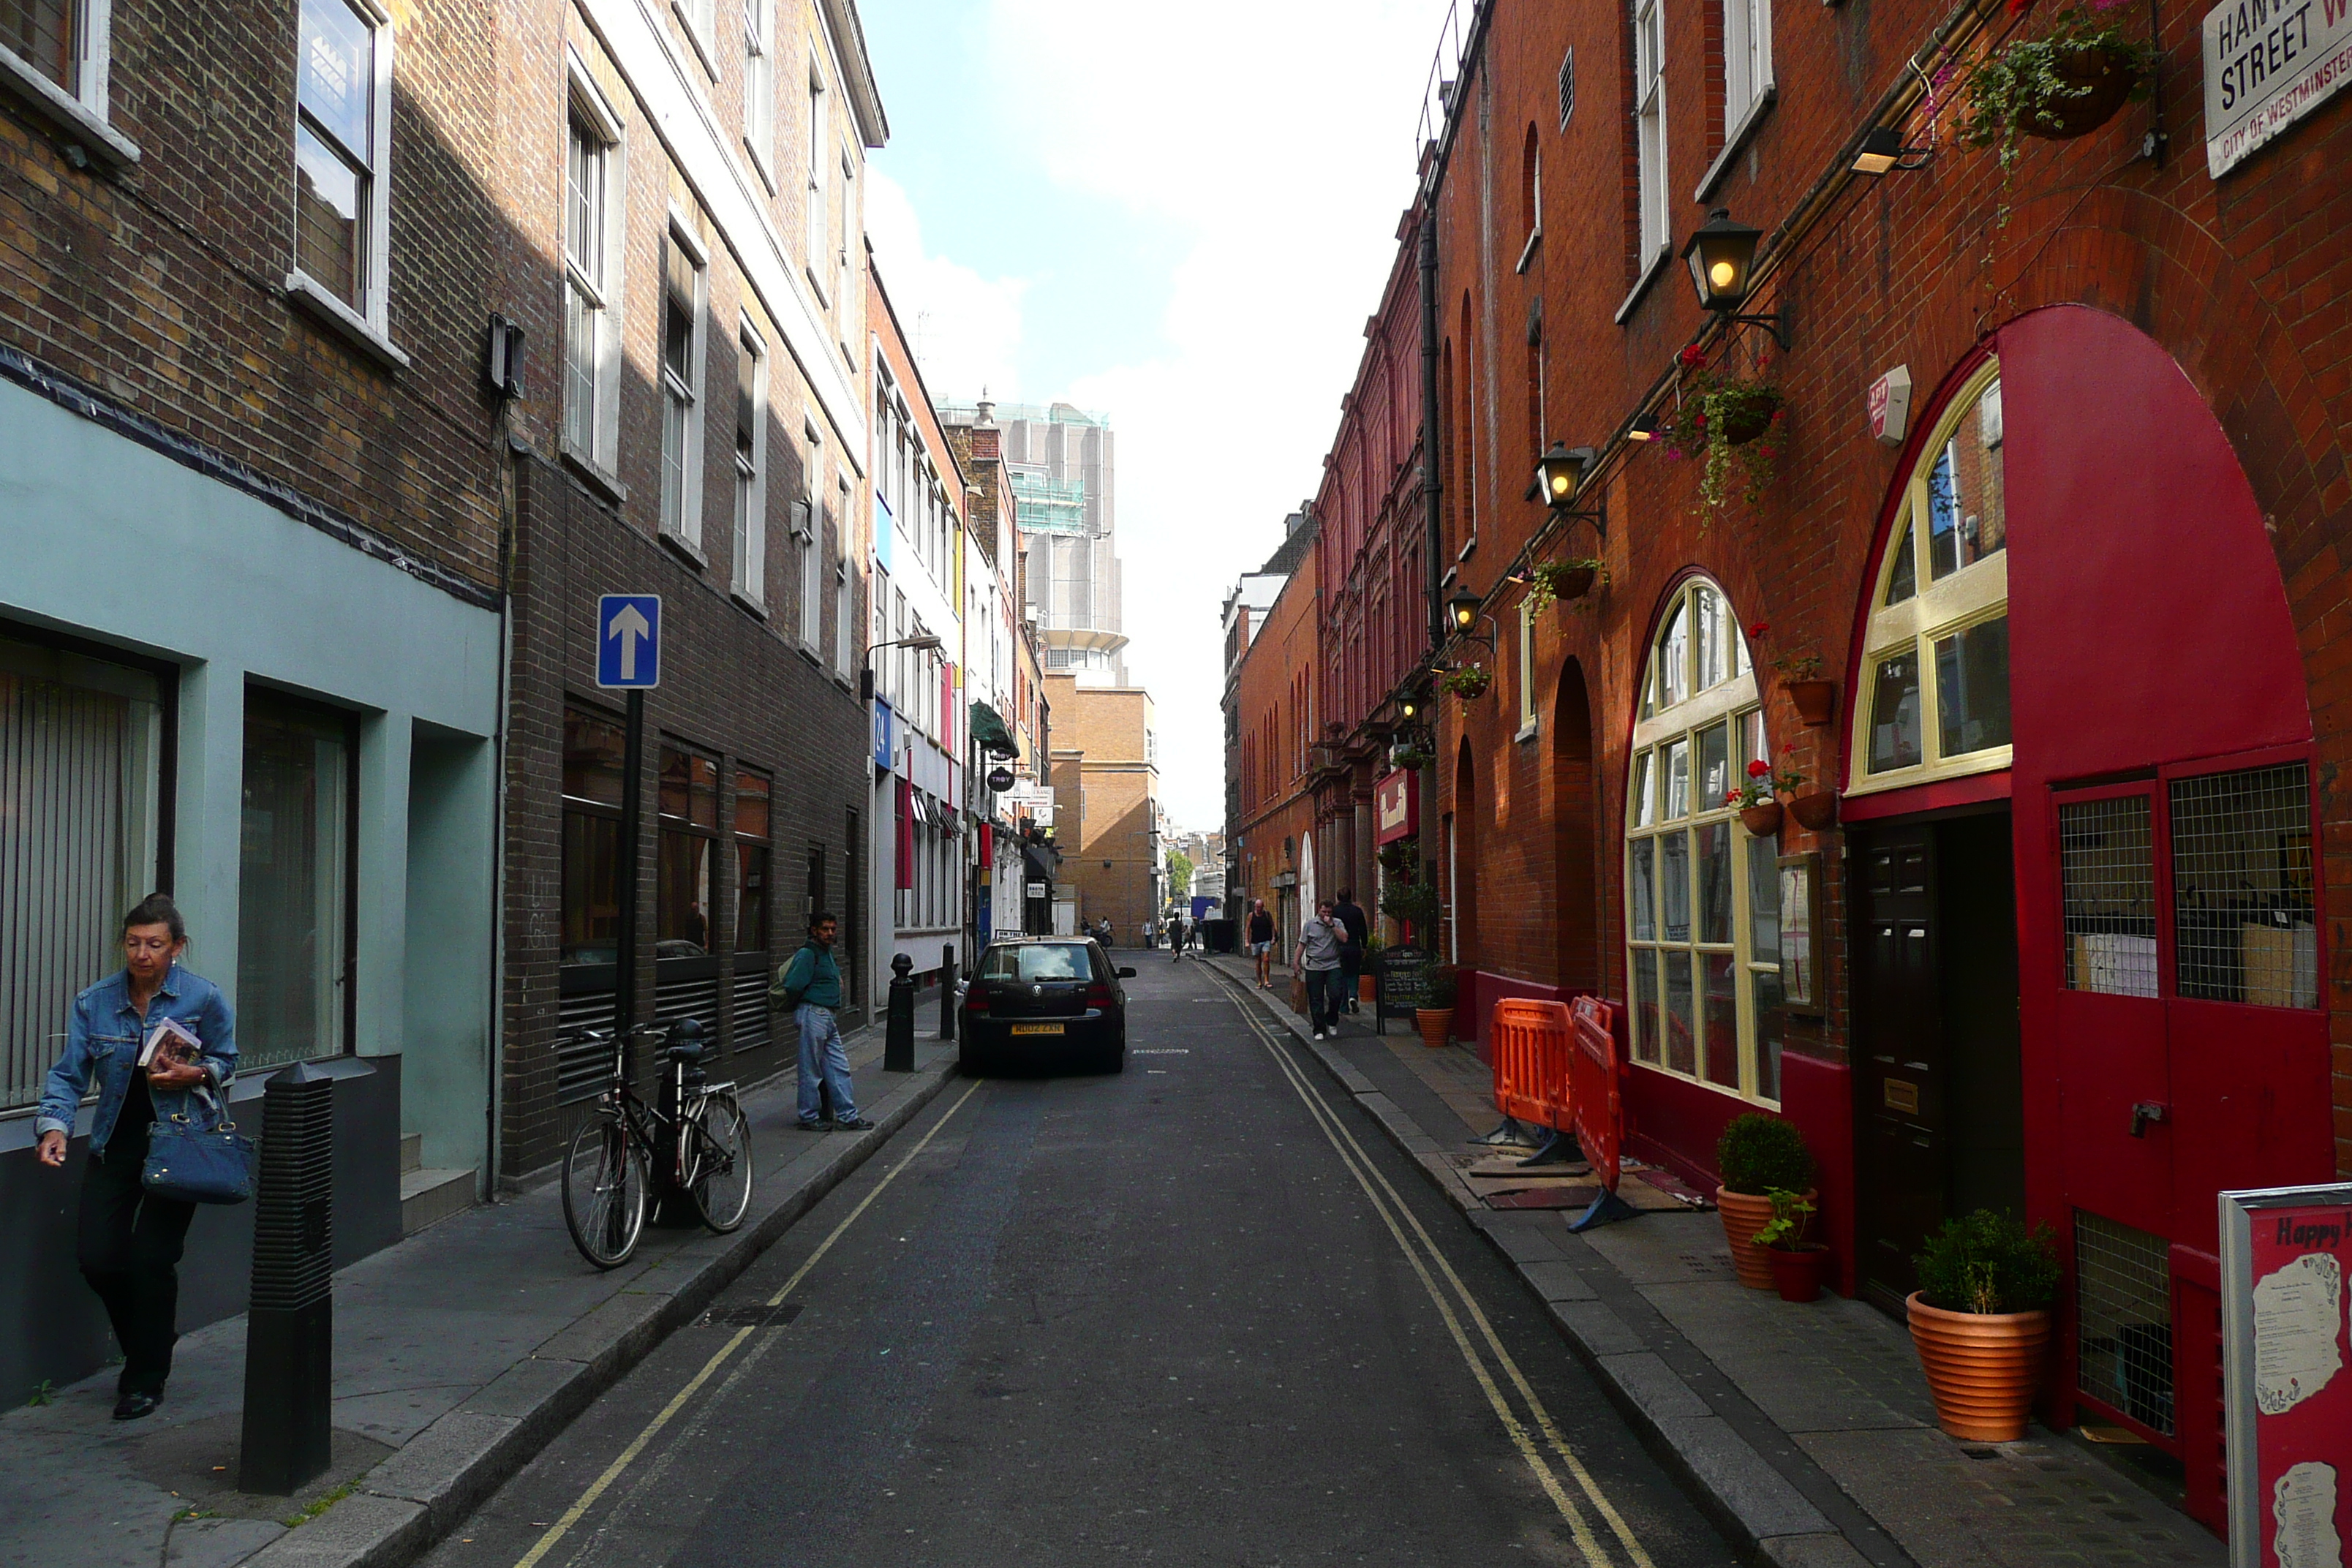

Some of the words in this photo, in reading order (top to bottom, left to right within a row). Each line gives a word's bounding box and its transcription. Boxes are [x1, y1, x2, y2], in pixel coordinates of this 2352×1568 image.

[2221, 1, 2311, 110] STREET
[2223, 127, 2245, 159] CITY
[2250, 113, 2264, 140] OF
[2266, 45, 2352, 126] WESTMINSTER
[1870, 381, 1887, 410] APT
[876, 712, 885, 753] 24
[2276, 1217, 2341, 1249] Happy
